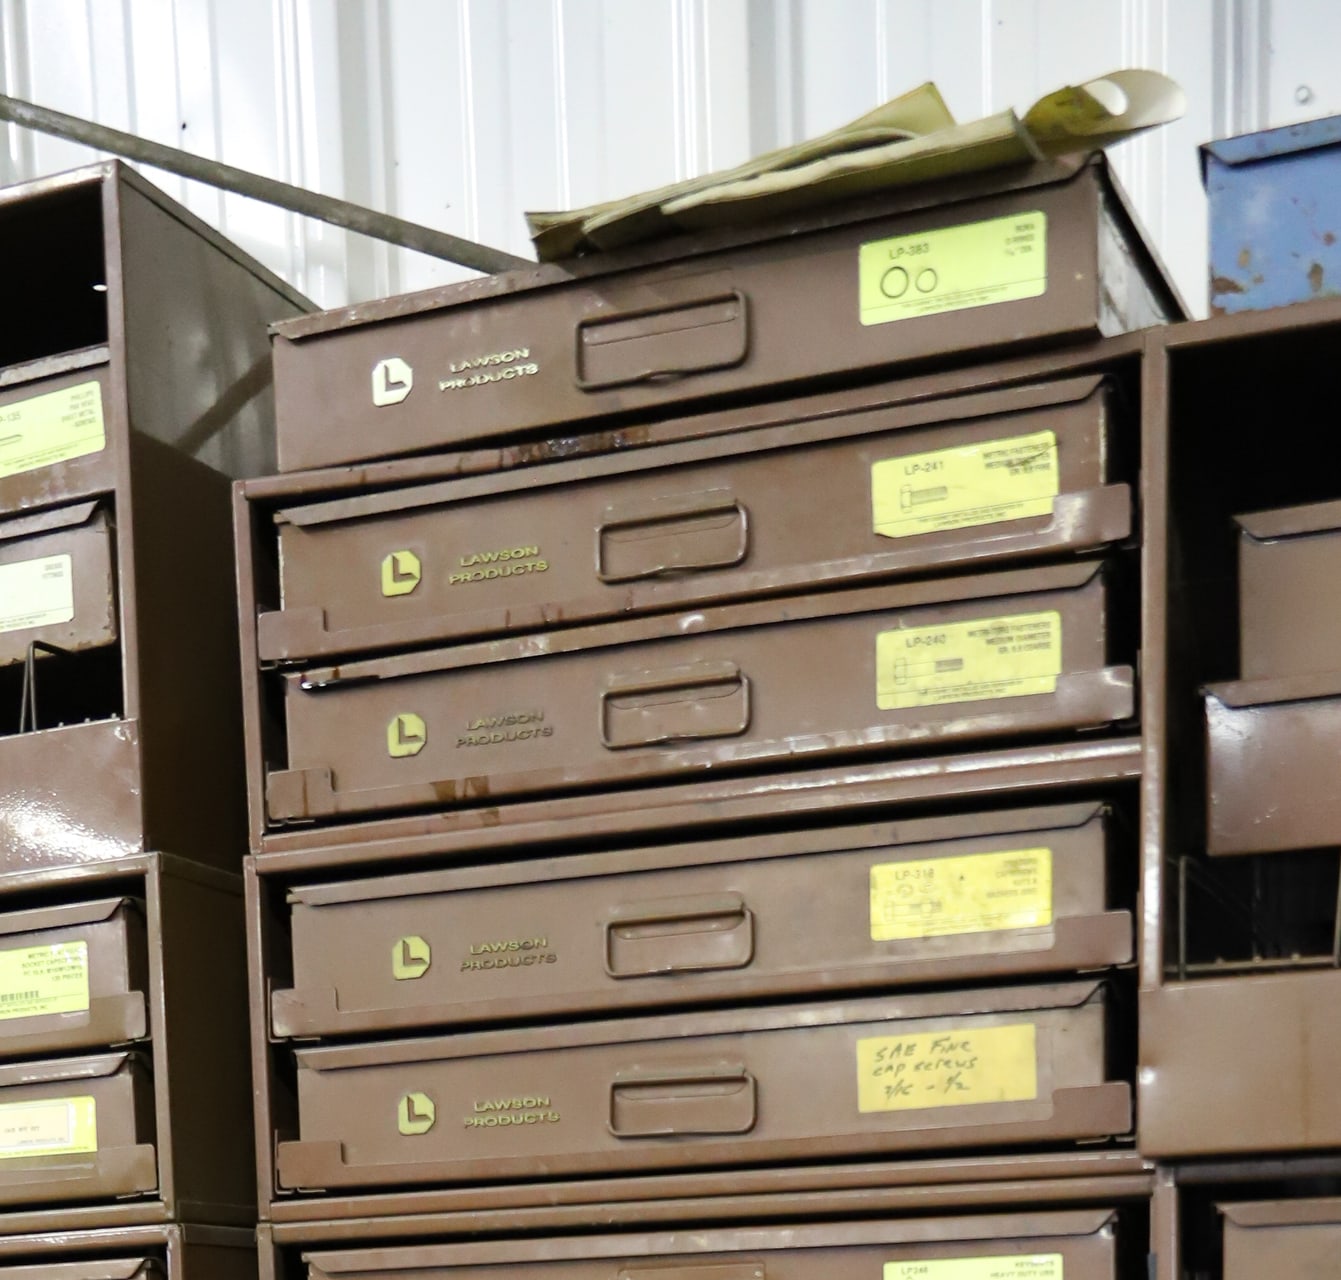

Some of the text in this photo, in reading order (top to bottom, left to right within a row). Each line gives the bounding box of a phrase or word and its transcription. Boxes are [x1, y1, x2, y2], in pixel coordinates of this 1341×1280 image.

[451, 347, 530, 374] LAWSON
[438, 363, 539, 392] PRODUCTS
[460, 547, 539, 567] LAWSON
[449, 560, 549, 586] PRODUCTS
[467, 712, 544, 731] LAWSON
[456, 727, 553, 749] PRODUCTS
[469, 938, 548, 955] LAWSON
[460, 954, 557, 972] PRODUCTS
[474, 1097, 551, 1113] LAWSON
[464, 1112, 561, 1129] PRODUCTS
